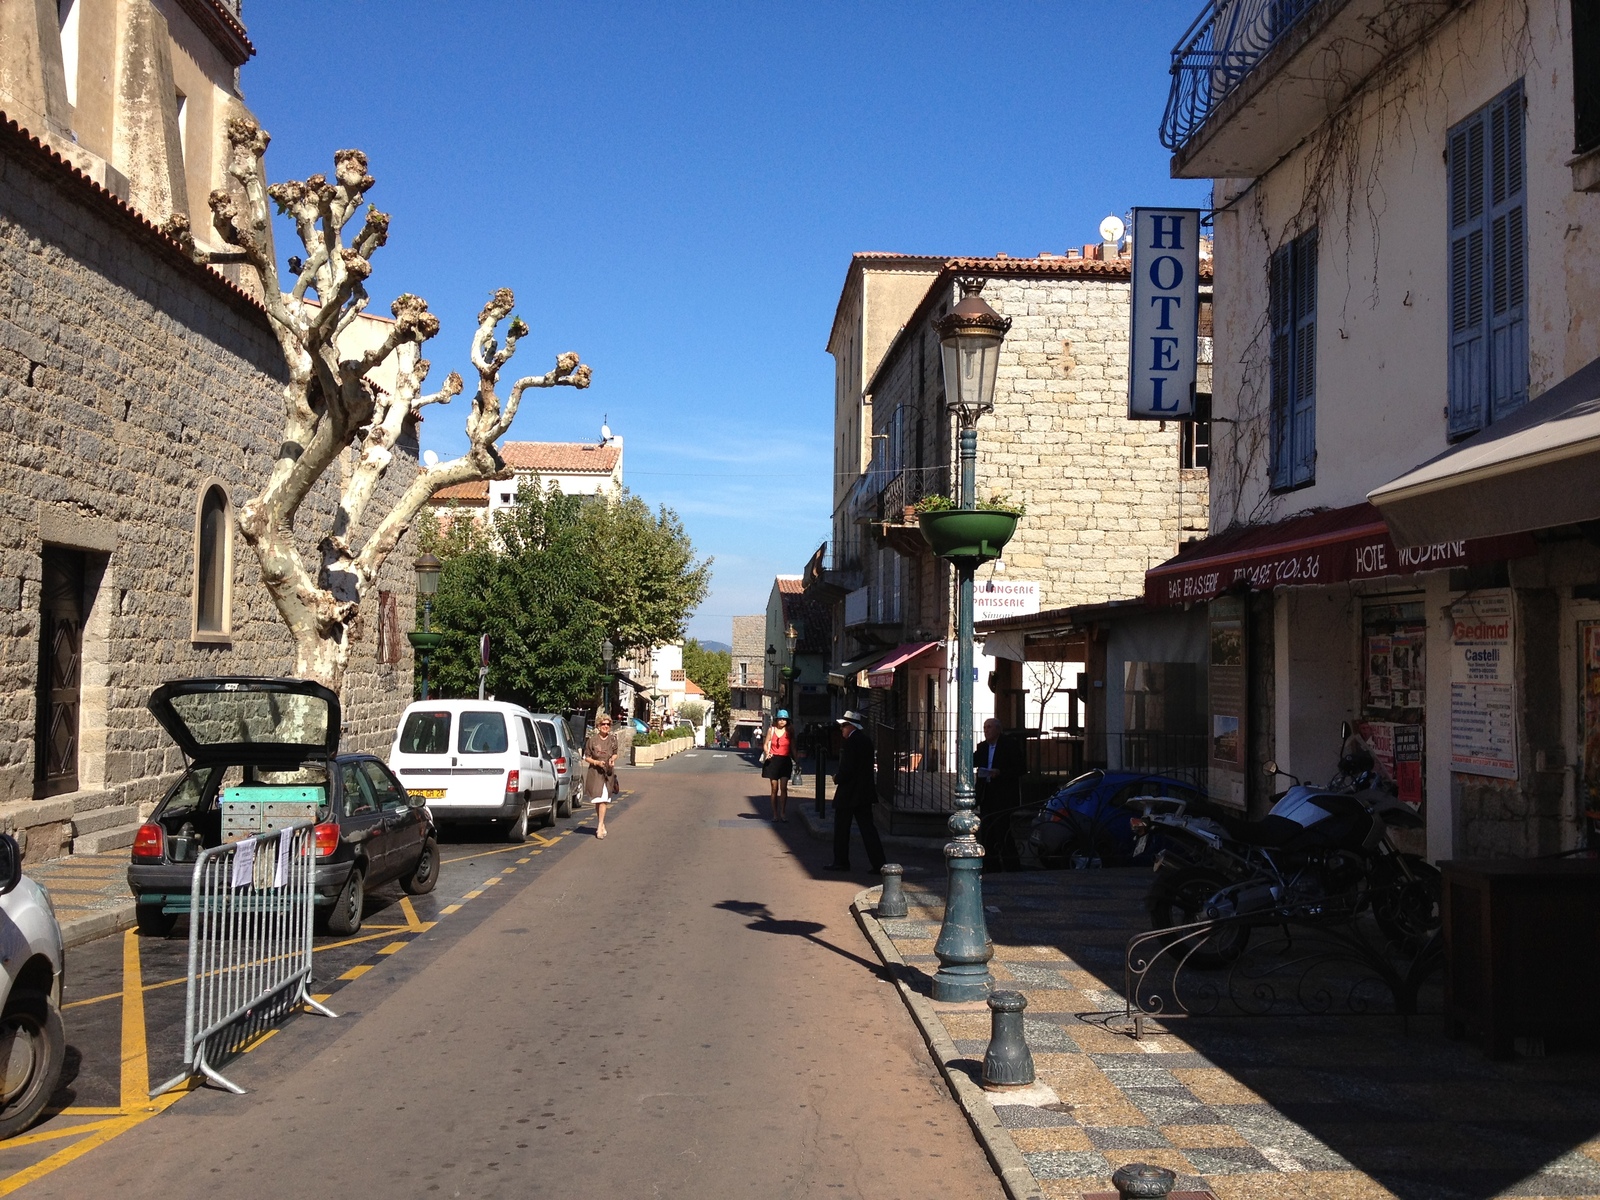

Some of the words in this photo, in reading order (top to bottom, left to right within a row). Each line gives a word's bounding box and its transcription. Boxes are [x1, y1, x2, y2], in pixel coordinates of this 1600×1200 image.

[1148, 214, 1185, 412] HOTEL
[1398, 540, 1465, 566] MODERNE
[1453, 621, 1509, 640] Gedimat
[1465, 648, 1500, 662] Castelli
